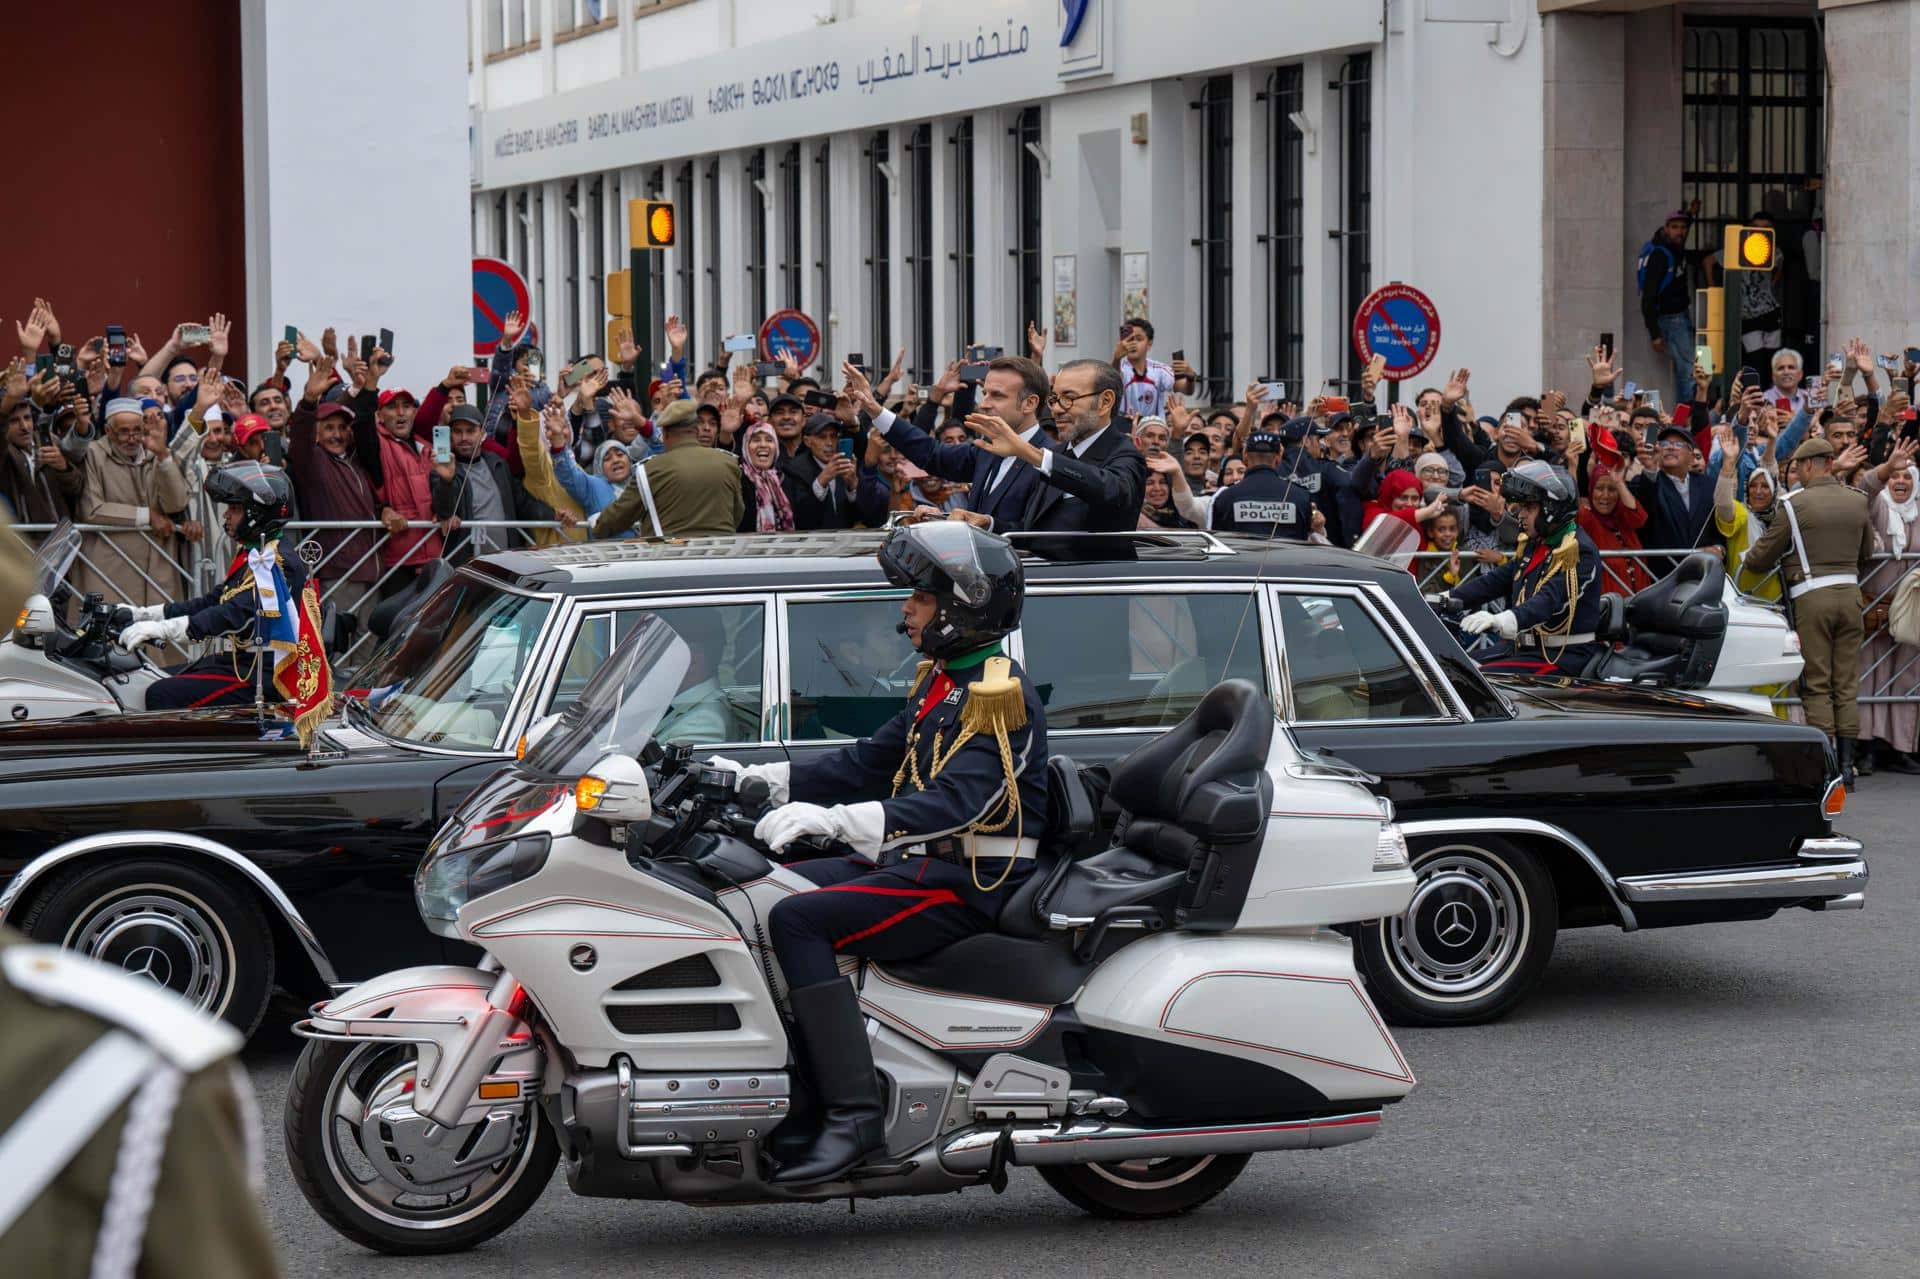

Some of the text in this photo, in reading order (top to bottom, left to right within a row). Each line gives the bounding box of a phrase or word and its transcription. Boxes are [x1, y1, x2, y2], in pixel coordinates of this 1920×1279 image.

[856, 18, 1029, 94] متحف بريد المغرب
[588, 113, 608, 140] BARID
[622, 102, 657, 133] MAGHRIB
[659, 96, 695, 125] MUSEUM
[1239, 502, 1290, 511] الشرطة
